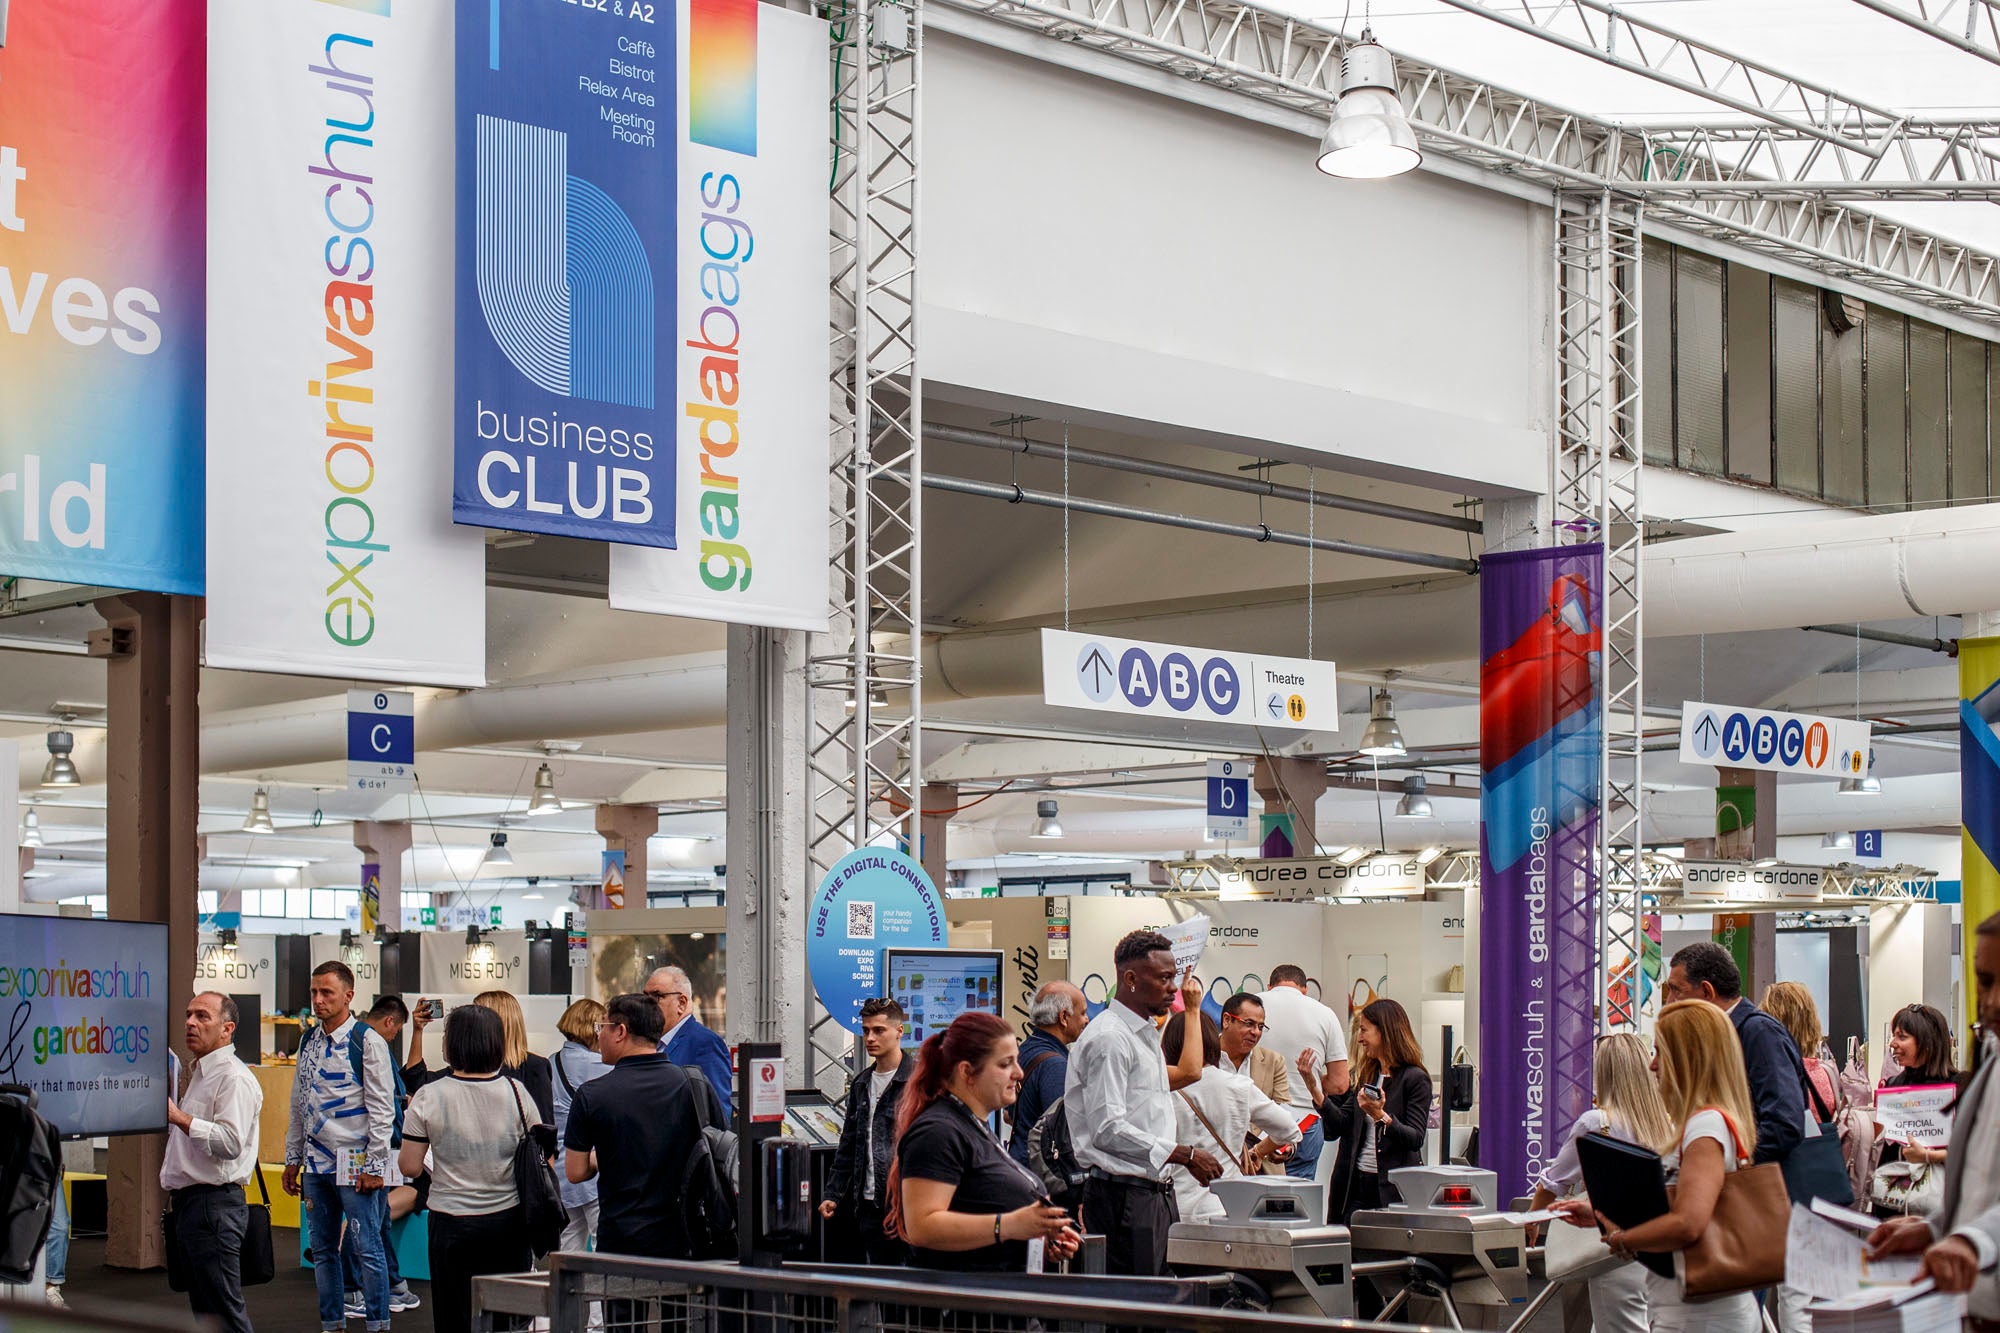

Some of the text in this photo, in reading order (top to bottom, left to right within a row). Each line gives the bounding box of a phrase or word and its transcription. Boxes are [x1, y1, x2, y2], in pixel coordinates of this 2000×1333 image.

[613, 1, 624, 16] &
[628, 1, 655, 24] A2
[617, 36, 655, 58] Caffè
[609, 58, 655, 83] Bistrot
[579, 76, 655, 107] Relax Area
[600, 105, 655, 135] Meeting
[612, 125, 655, 148] Room
[308, 32, 390, 648] exporivaschuh
[686, 171, 754, 592] gardabags
[477, 400, 654, 462] business
[477, 450, 654, 524] CLUB
[1264, 670, 1305, 686] Theatre
[375, 695, 387, 708] D
[1221, 778, 1235, 809] b
[1863, 832, 1874, 852] a
[1227, 862, 1417, 882] andrea cardone
[1687, 867, 1819, 885] andrea cardone
[1525, 806, 1551, 962] gardabags
[815, 857, 940, 941] USE THE DIGITAL CONNECTION!
[1055, 906, 1067, 915] C21
[1209, 925, 1259, 937] ardone
[356, 963, 379, 979] ROY
[449, 962, 481, 979] MISS
[857, 957, 874, 965] EXPO
[861, 980, 874, 988] APP
[1530, 976, 1543, 988] &
[33, 1017, 150, 1065] gardabags
[42, 1080, 63, 1092] that
[67, 1080, 100, 1091] moves
[103, 1078, 119, 1090] the
[123, 1076, 150, 1088] world
[1895, 1119, 1934, 1129] OFFICIAL
